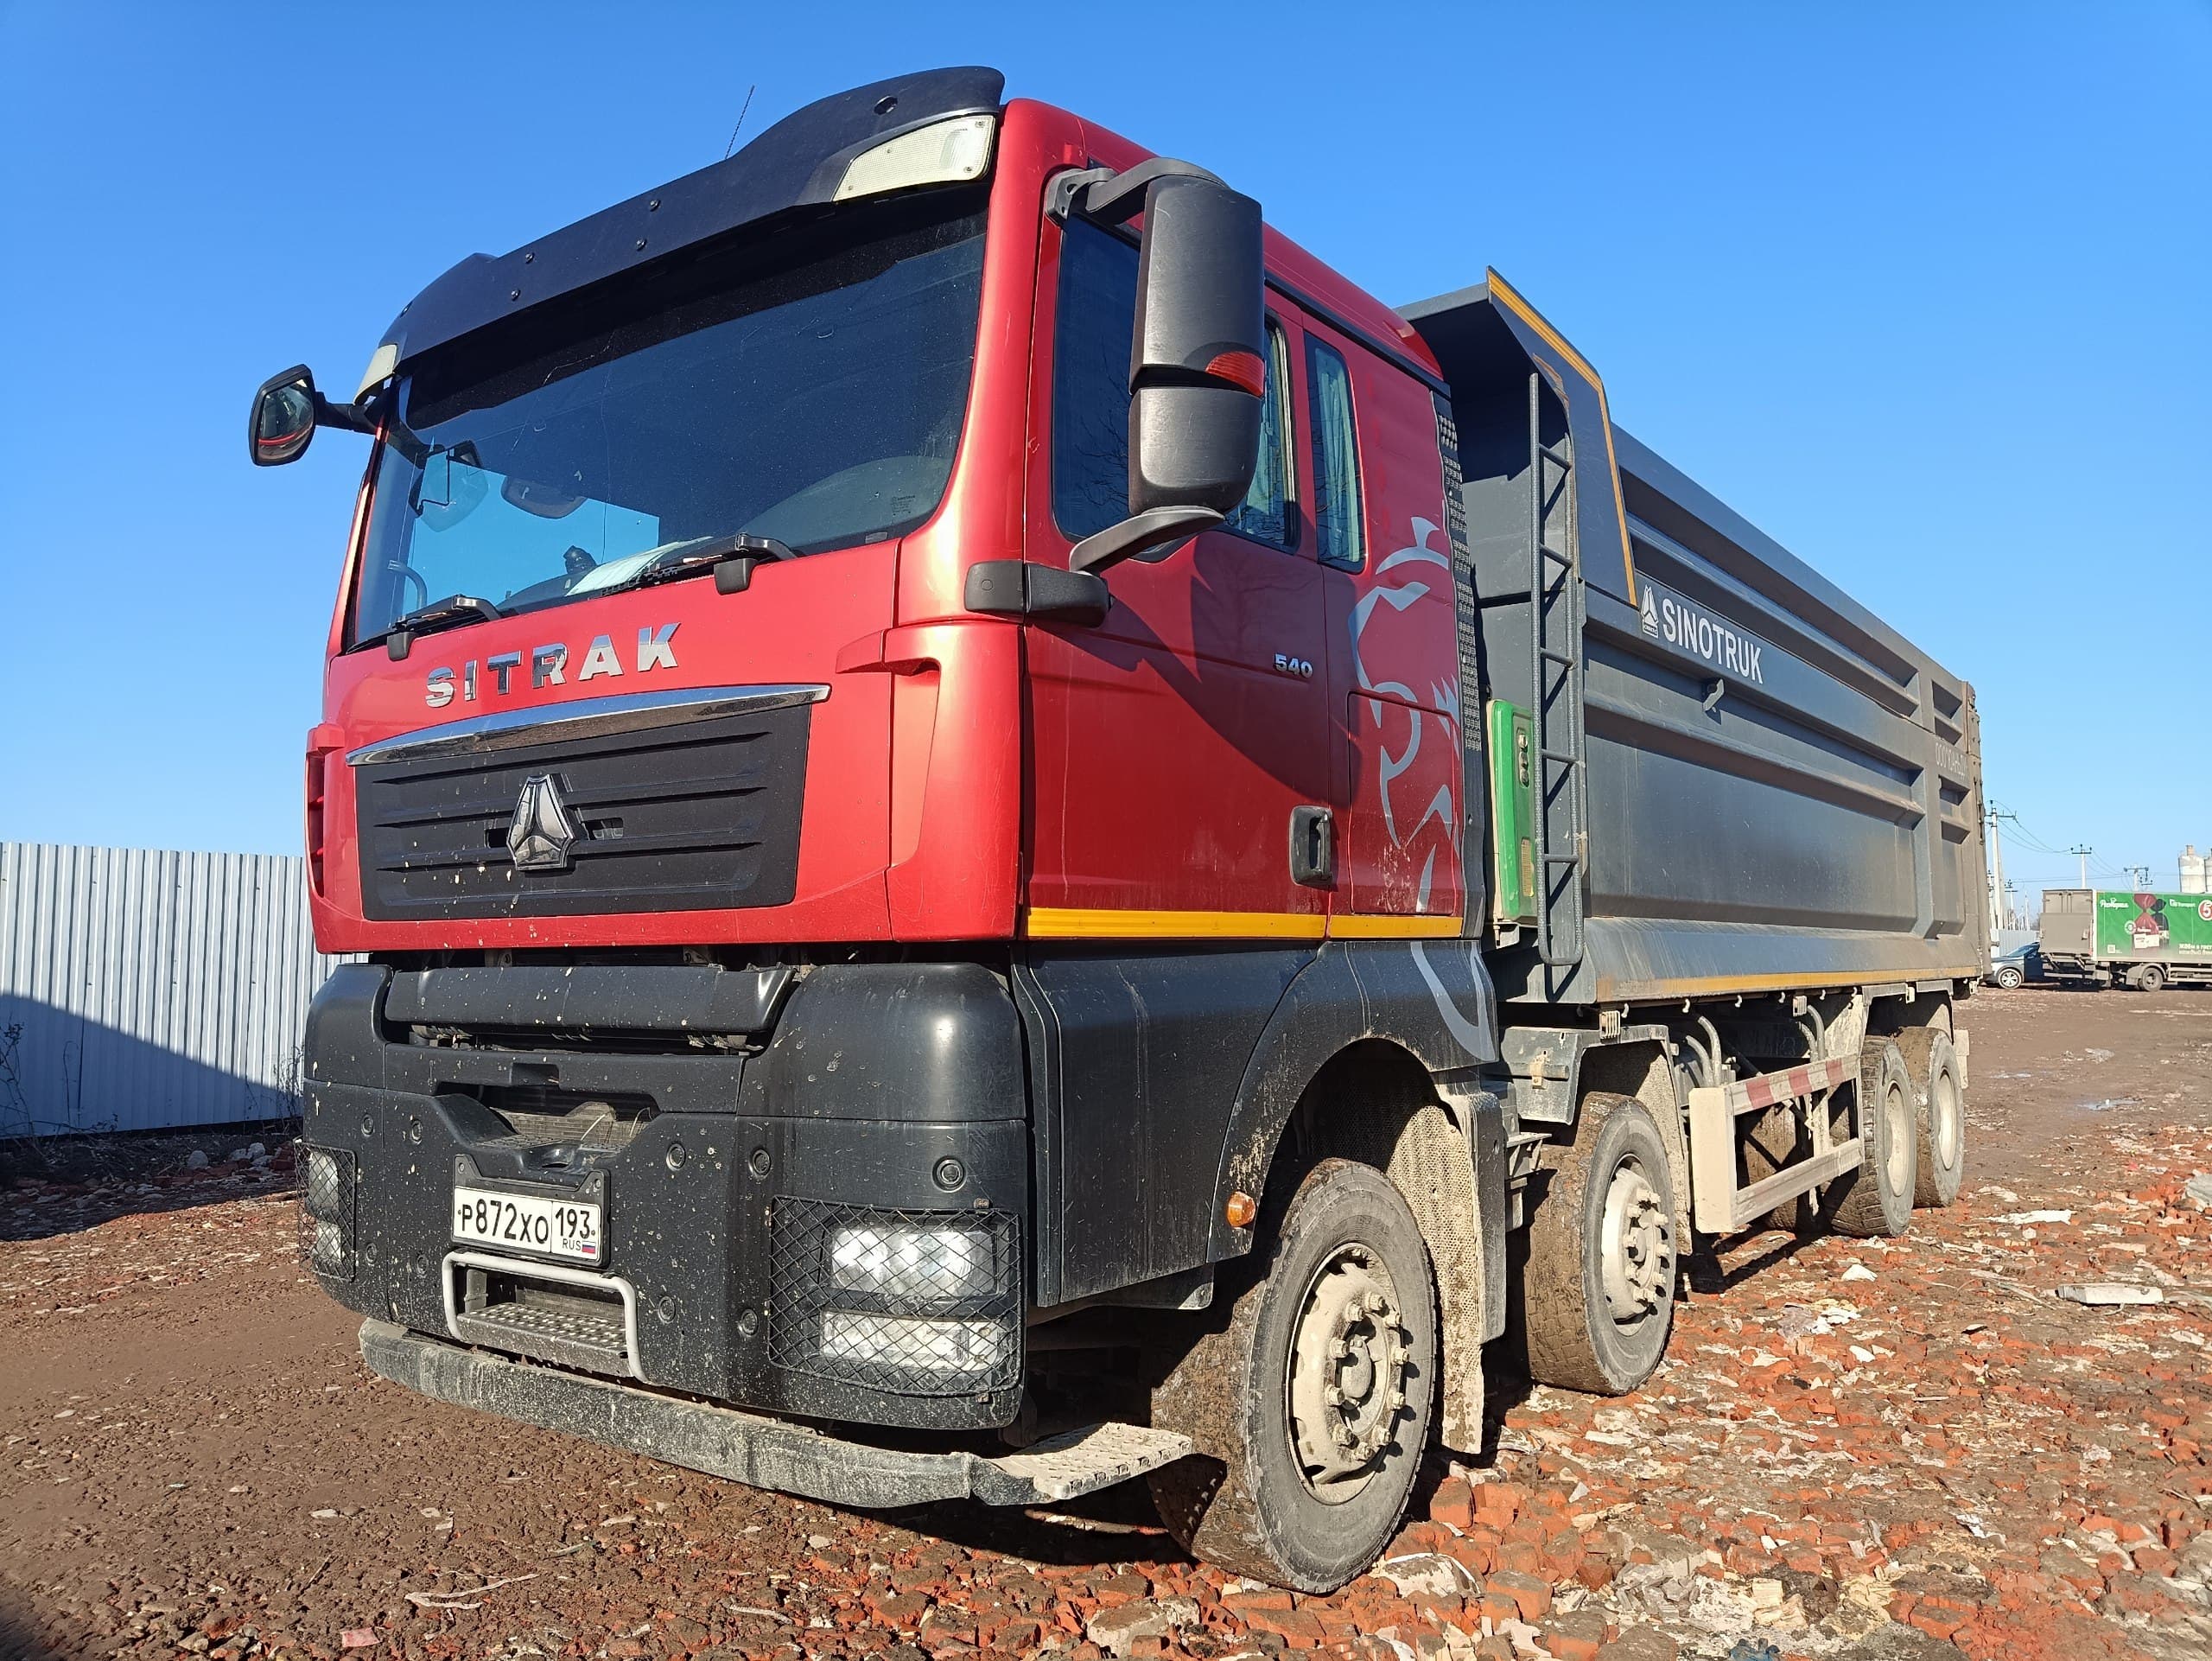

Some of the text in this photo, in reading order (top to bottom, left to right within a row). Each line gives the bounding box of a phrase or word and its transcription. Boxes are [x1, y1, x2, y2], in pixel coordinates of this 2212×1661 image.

[1662, 598, 1764, 684] SINOTRUK
[424, 621, 682, 708] SITRAK
[1274, 652, 1313, 678] 540
[555, 1207, 590, 1239] 193
[562, 1238, 582, 1251] RUS
